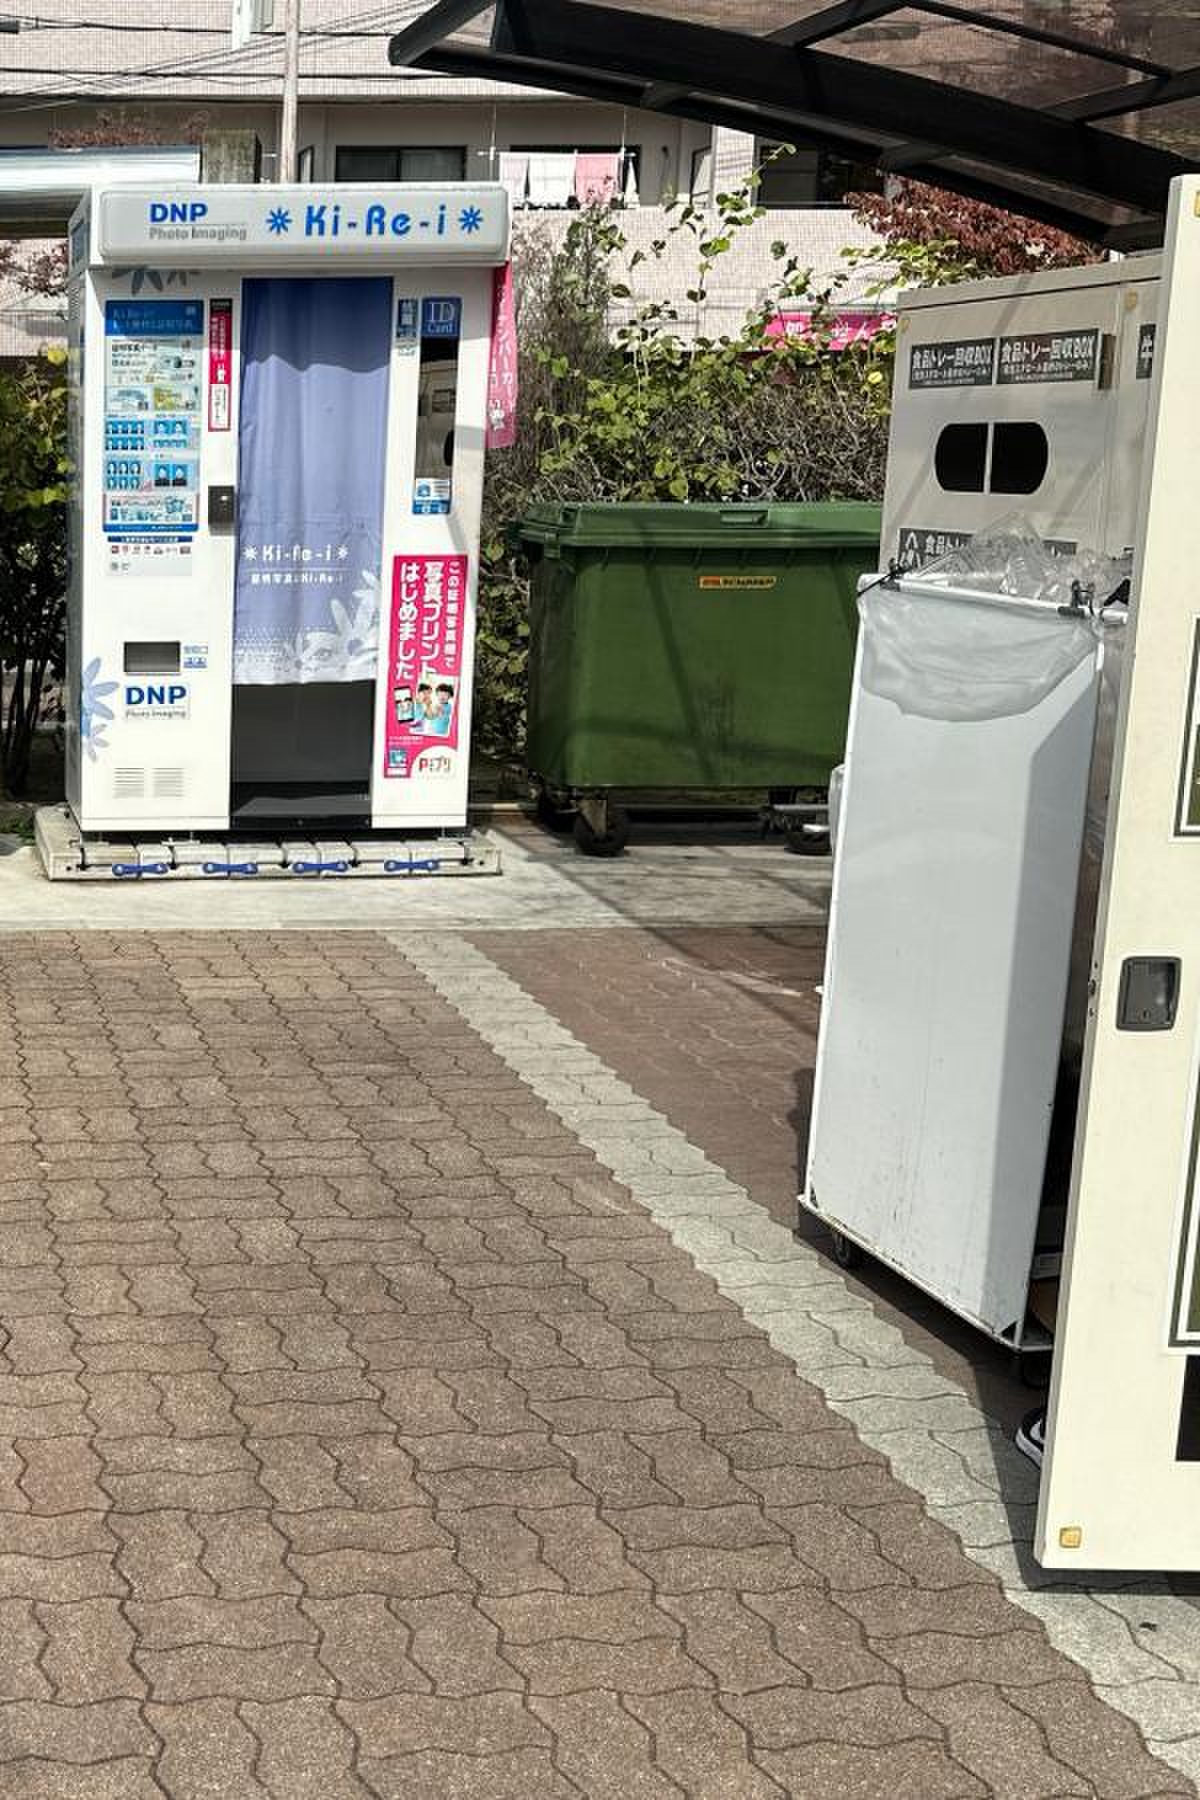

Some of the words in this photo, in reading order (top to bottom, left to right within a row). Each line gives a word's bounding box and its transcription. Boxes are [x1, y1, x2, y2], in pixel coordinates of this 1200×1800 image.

[150, 203, 208, 223] DNP
[304, 204, 447, 236] Ki-Re-i
[149, 227, 189, 239] Photo
[191, 226, 247, 241] Imaging
[427, 303, 455, 321] ID
[427, 323, 452, 334] Card
[912, 346, 993, 368] 食品トレー回収BOX
[1000, 336, 1096, 363] 食品トレー回収BOX
[395, 562, 420, 680] はじめました
[420, 561, 445, 676] 写真プリント
[126, 686, 187, 705] DNP
[152, 709, 186, 718] Imaging
